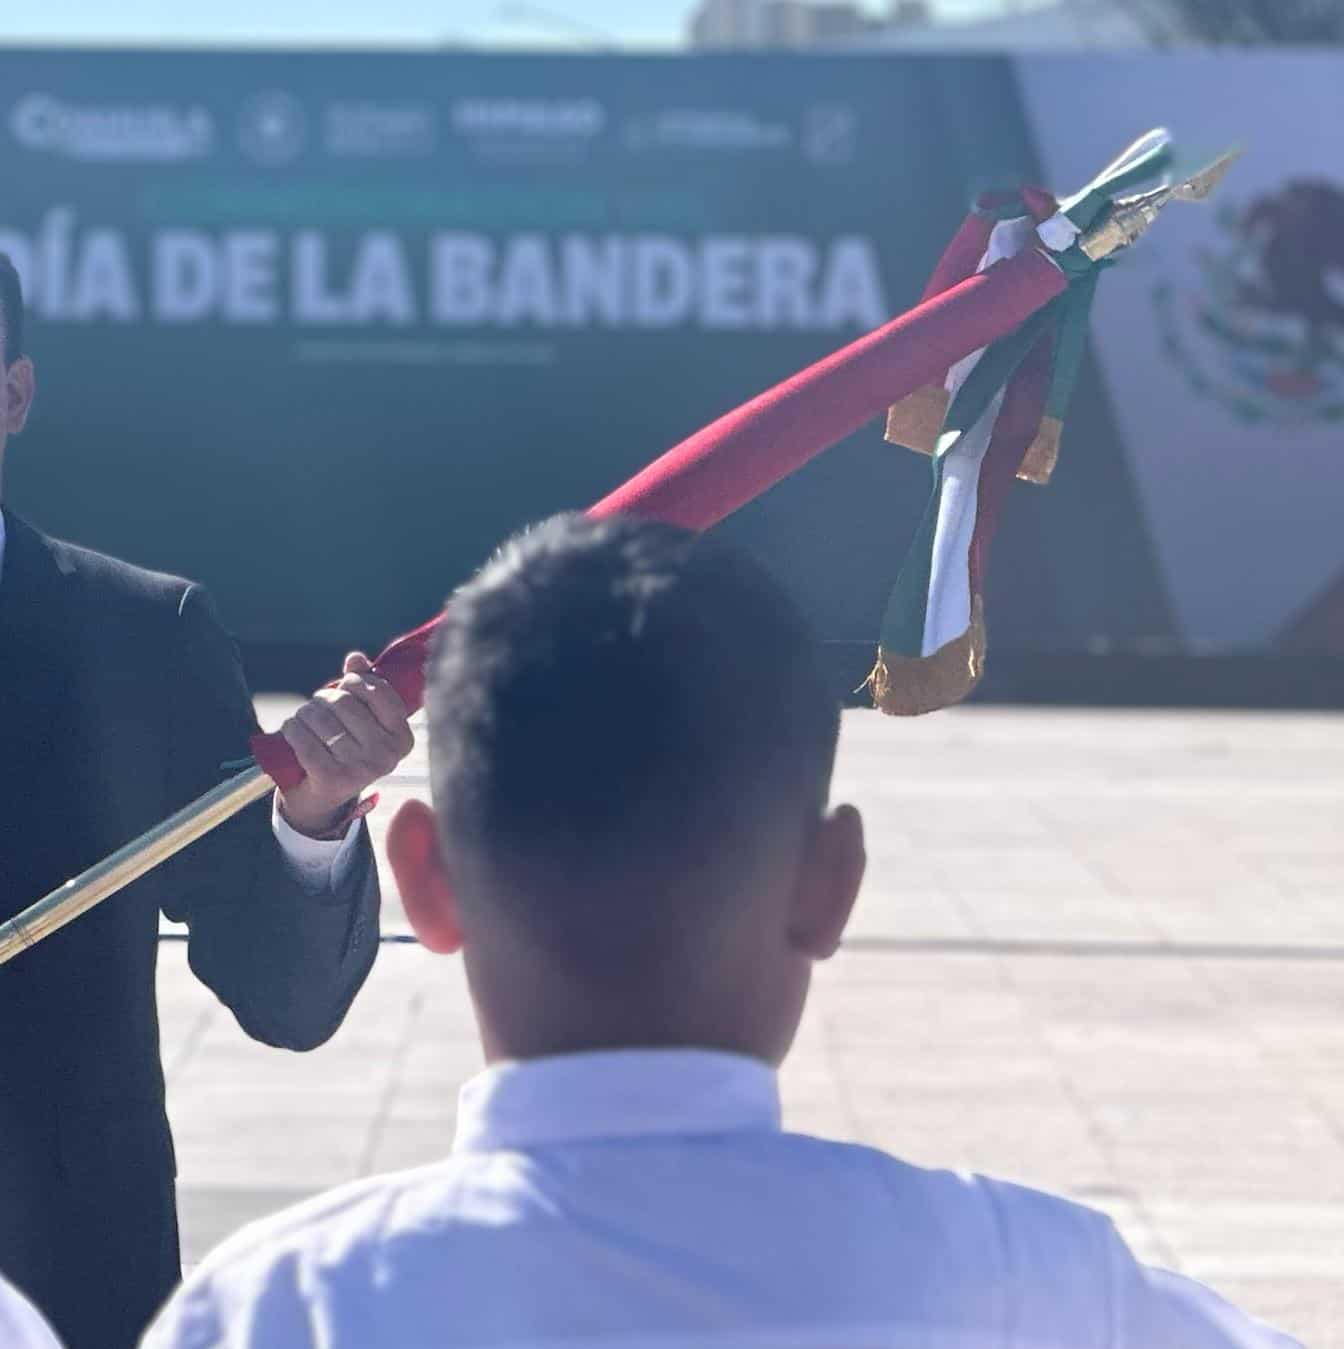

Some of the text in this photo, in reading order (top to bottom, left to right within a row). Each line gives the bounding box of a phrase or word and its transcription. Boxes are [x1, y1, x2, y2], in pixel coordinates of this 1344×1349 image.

[154, 235, 273, 321] DE
[295, 236, 411, 322] LA
[436, 237, 882, 328] BANDERA
